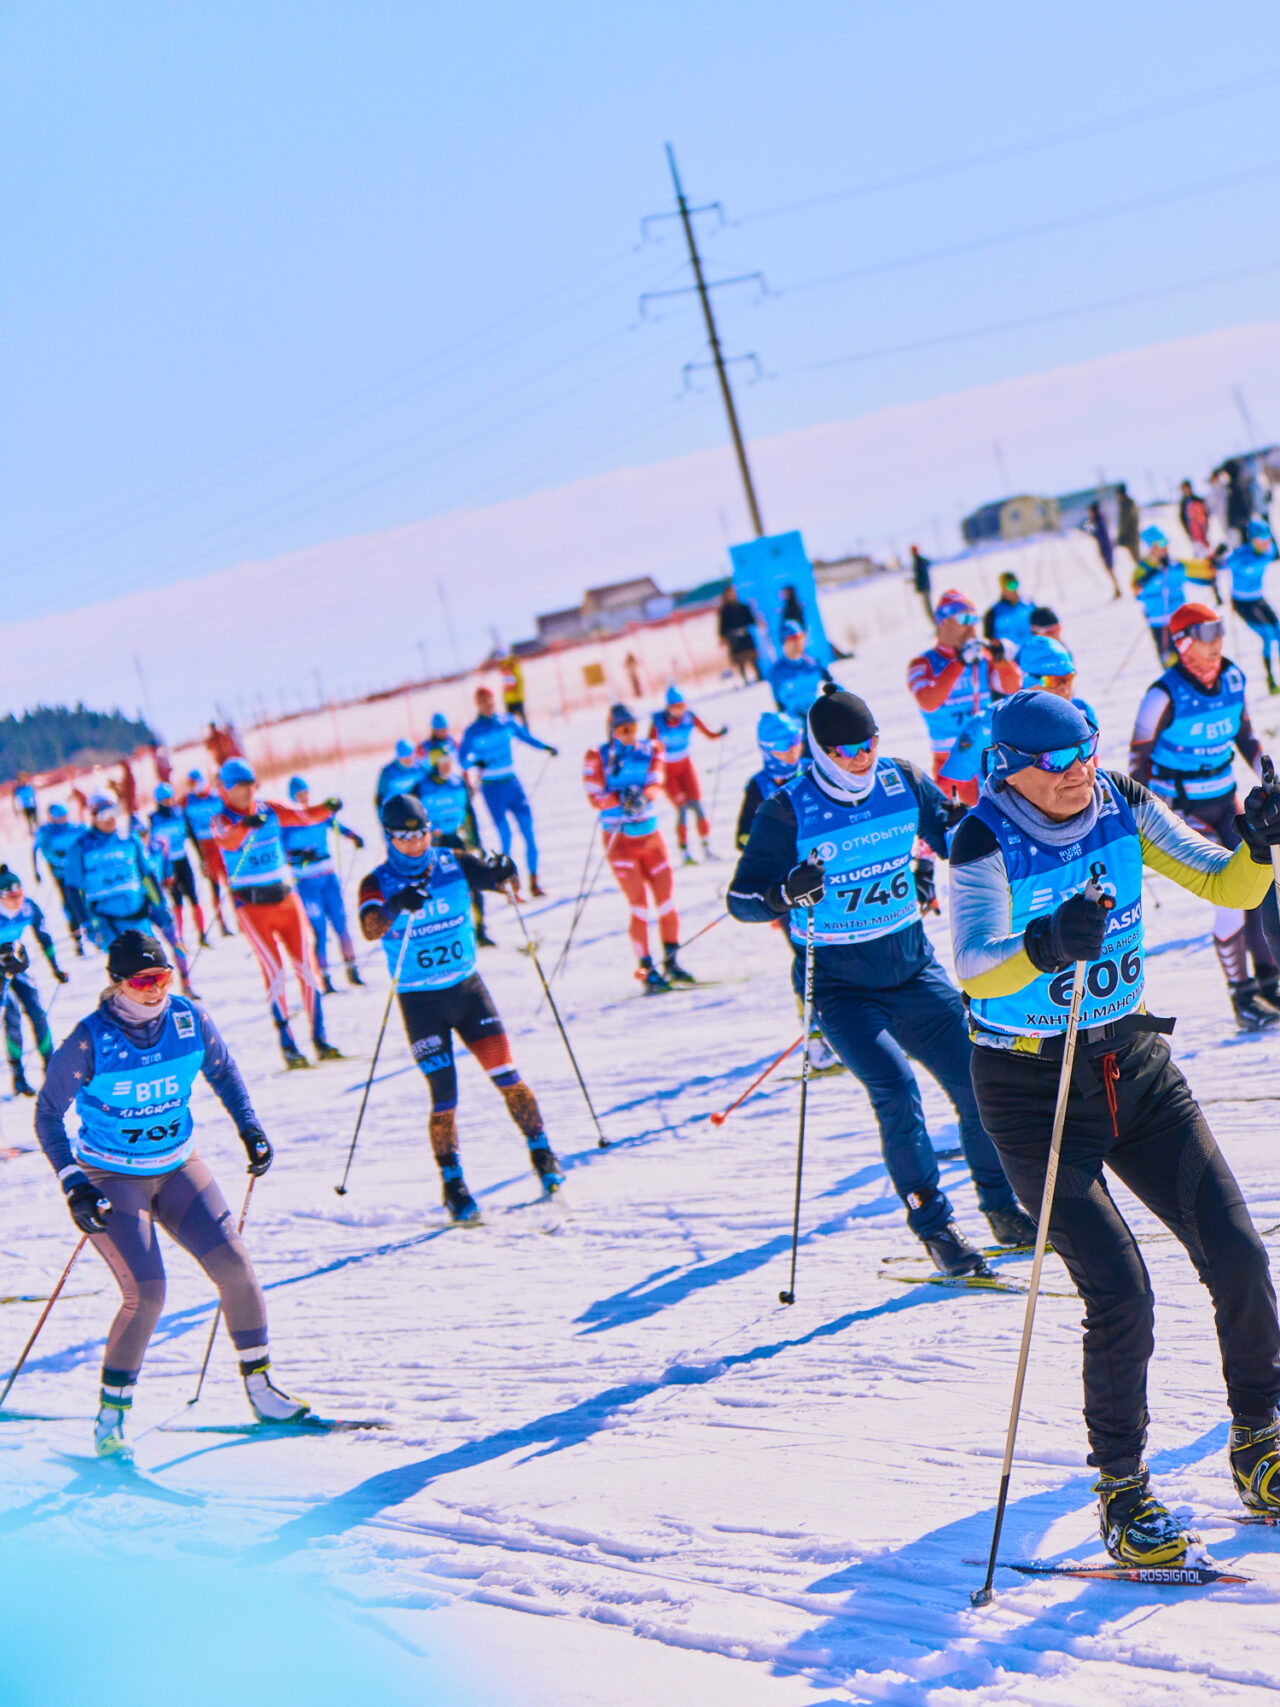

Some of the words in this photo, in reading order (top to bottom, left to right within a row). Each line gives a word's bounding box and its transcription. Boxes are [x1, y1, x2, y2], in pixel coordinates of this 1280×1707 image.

[841, 822, 916, 851] открытие
[829, 874, 847, 885] XI
[848, 854, 909, 882] UGRASKI
[836, 871, 909, 913] 746
[417, 941, 464, 969] 620
[1048, 944, 1142, 1008] 606
[136, 1075, 179, 1102] ВТБ
[1139, 1570, 1203, 1584] ROSSIGNOL
